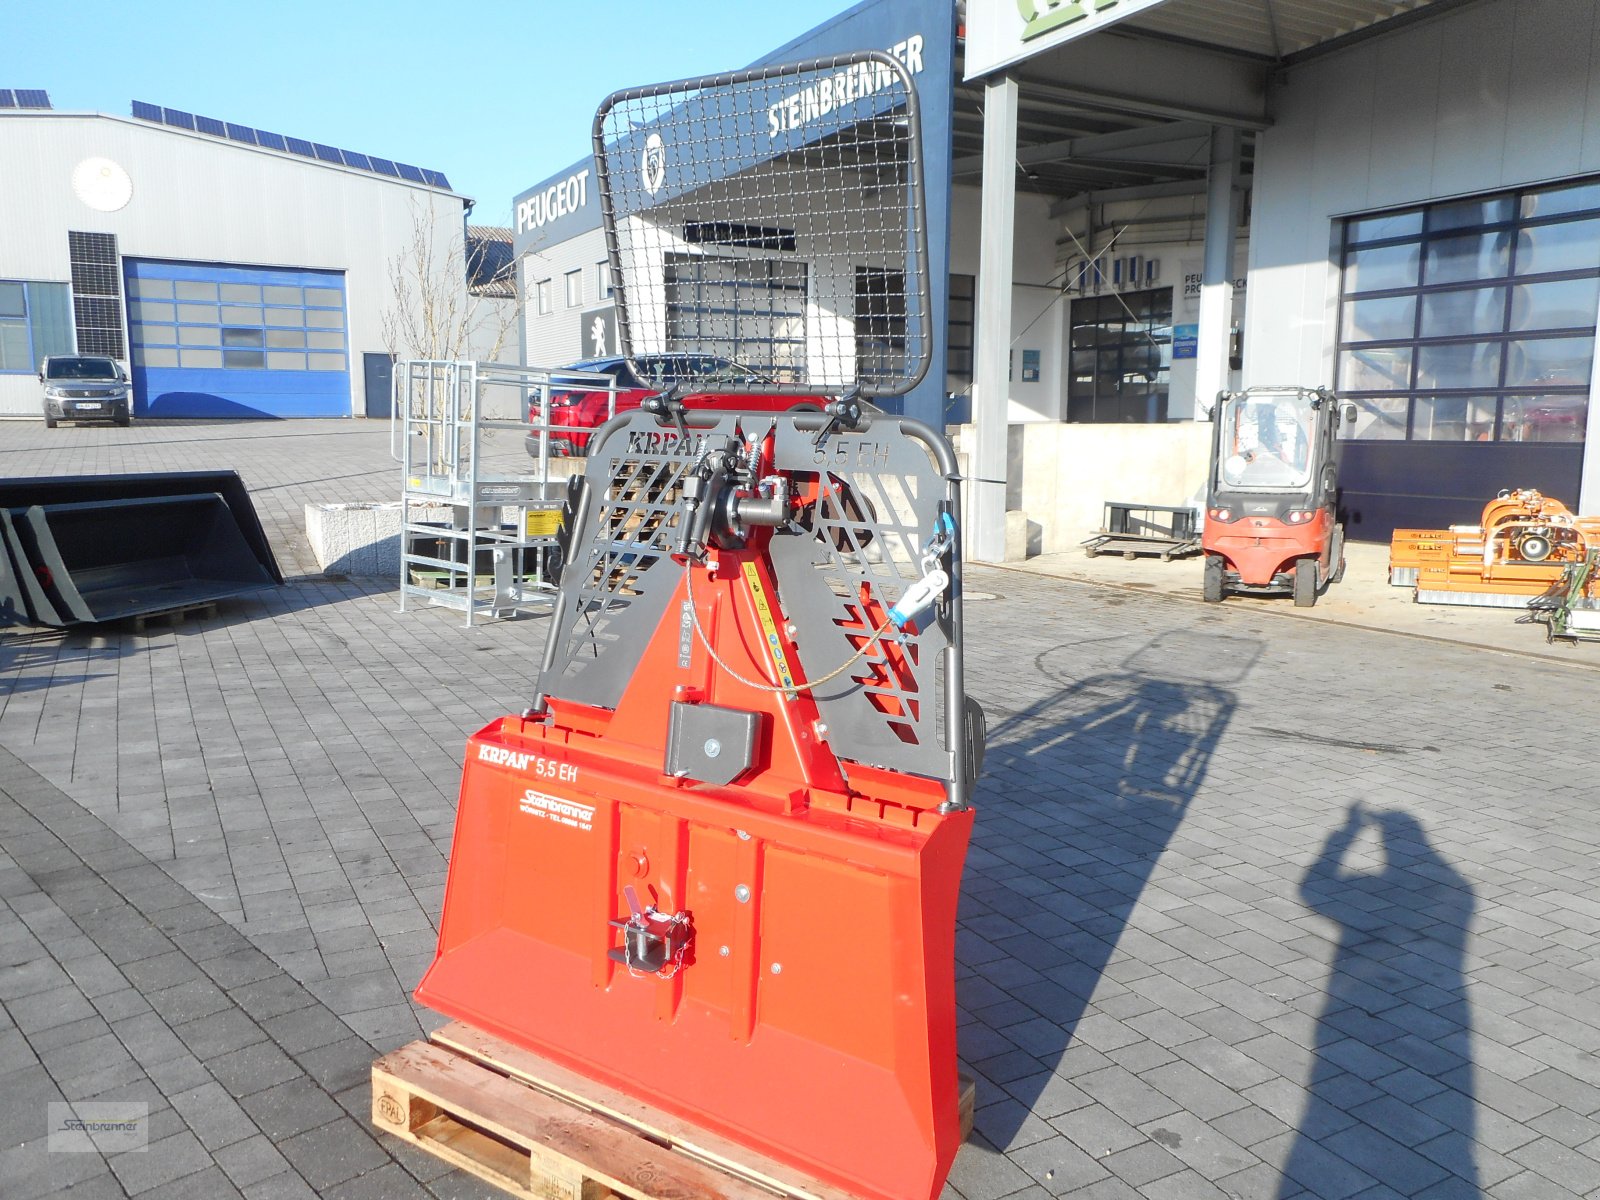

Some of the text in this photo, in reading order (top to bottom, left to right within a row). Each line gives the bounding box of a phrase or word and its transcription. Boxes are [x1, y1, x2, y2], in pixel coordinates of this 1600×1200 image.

[517, 169, 590, 235] PEUGEOT
[626, 431, 702, 457] KRPA
[536, 758, 557, 778] 5,5
[559, 763, 579, 783] EH
[520, 789, 595, 822] Steinbrenner
[381, 1099, 402, 1122] EPAL
